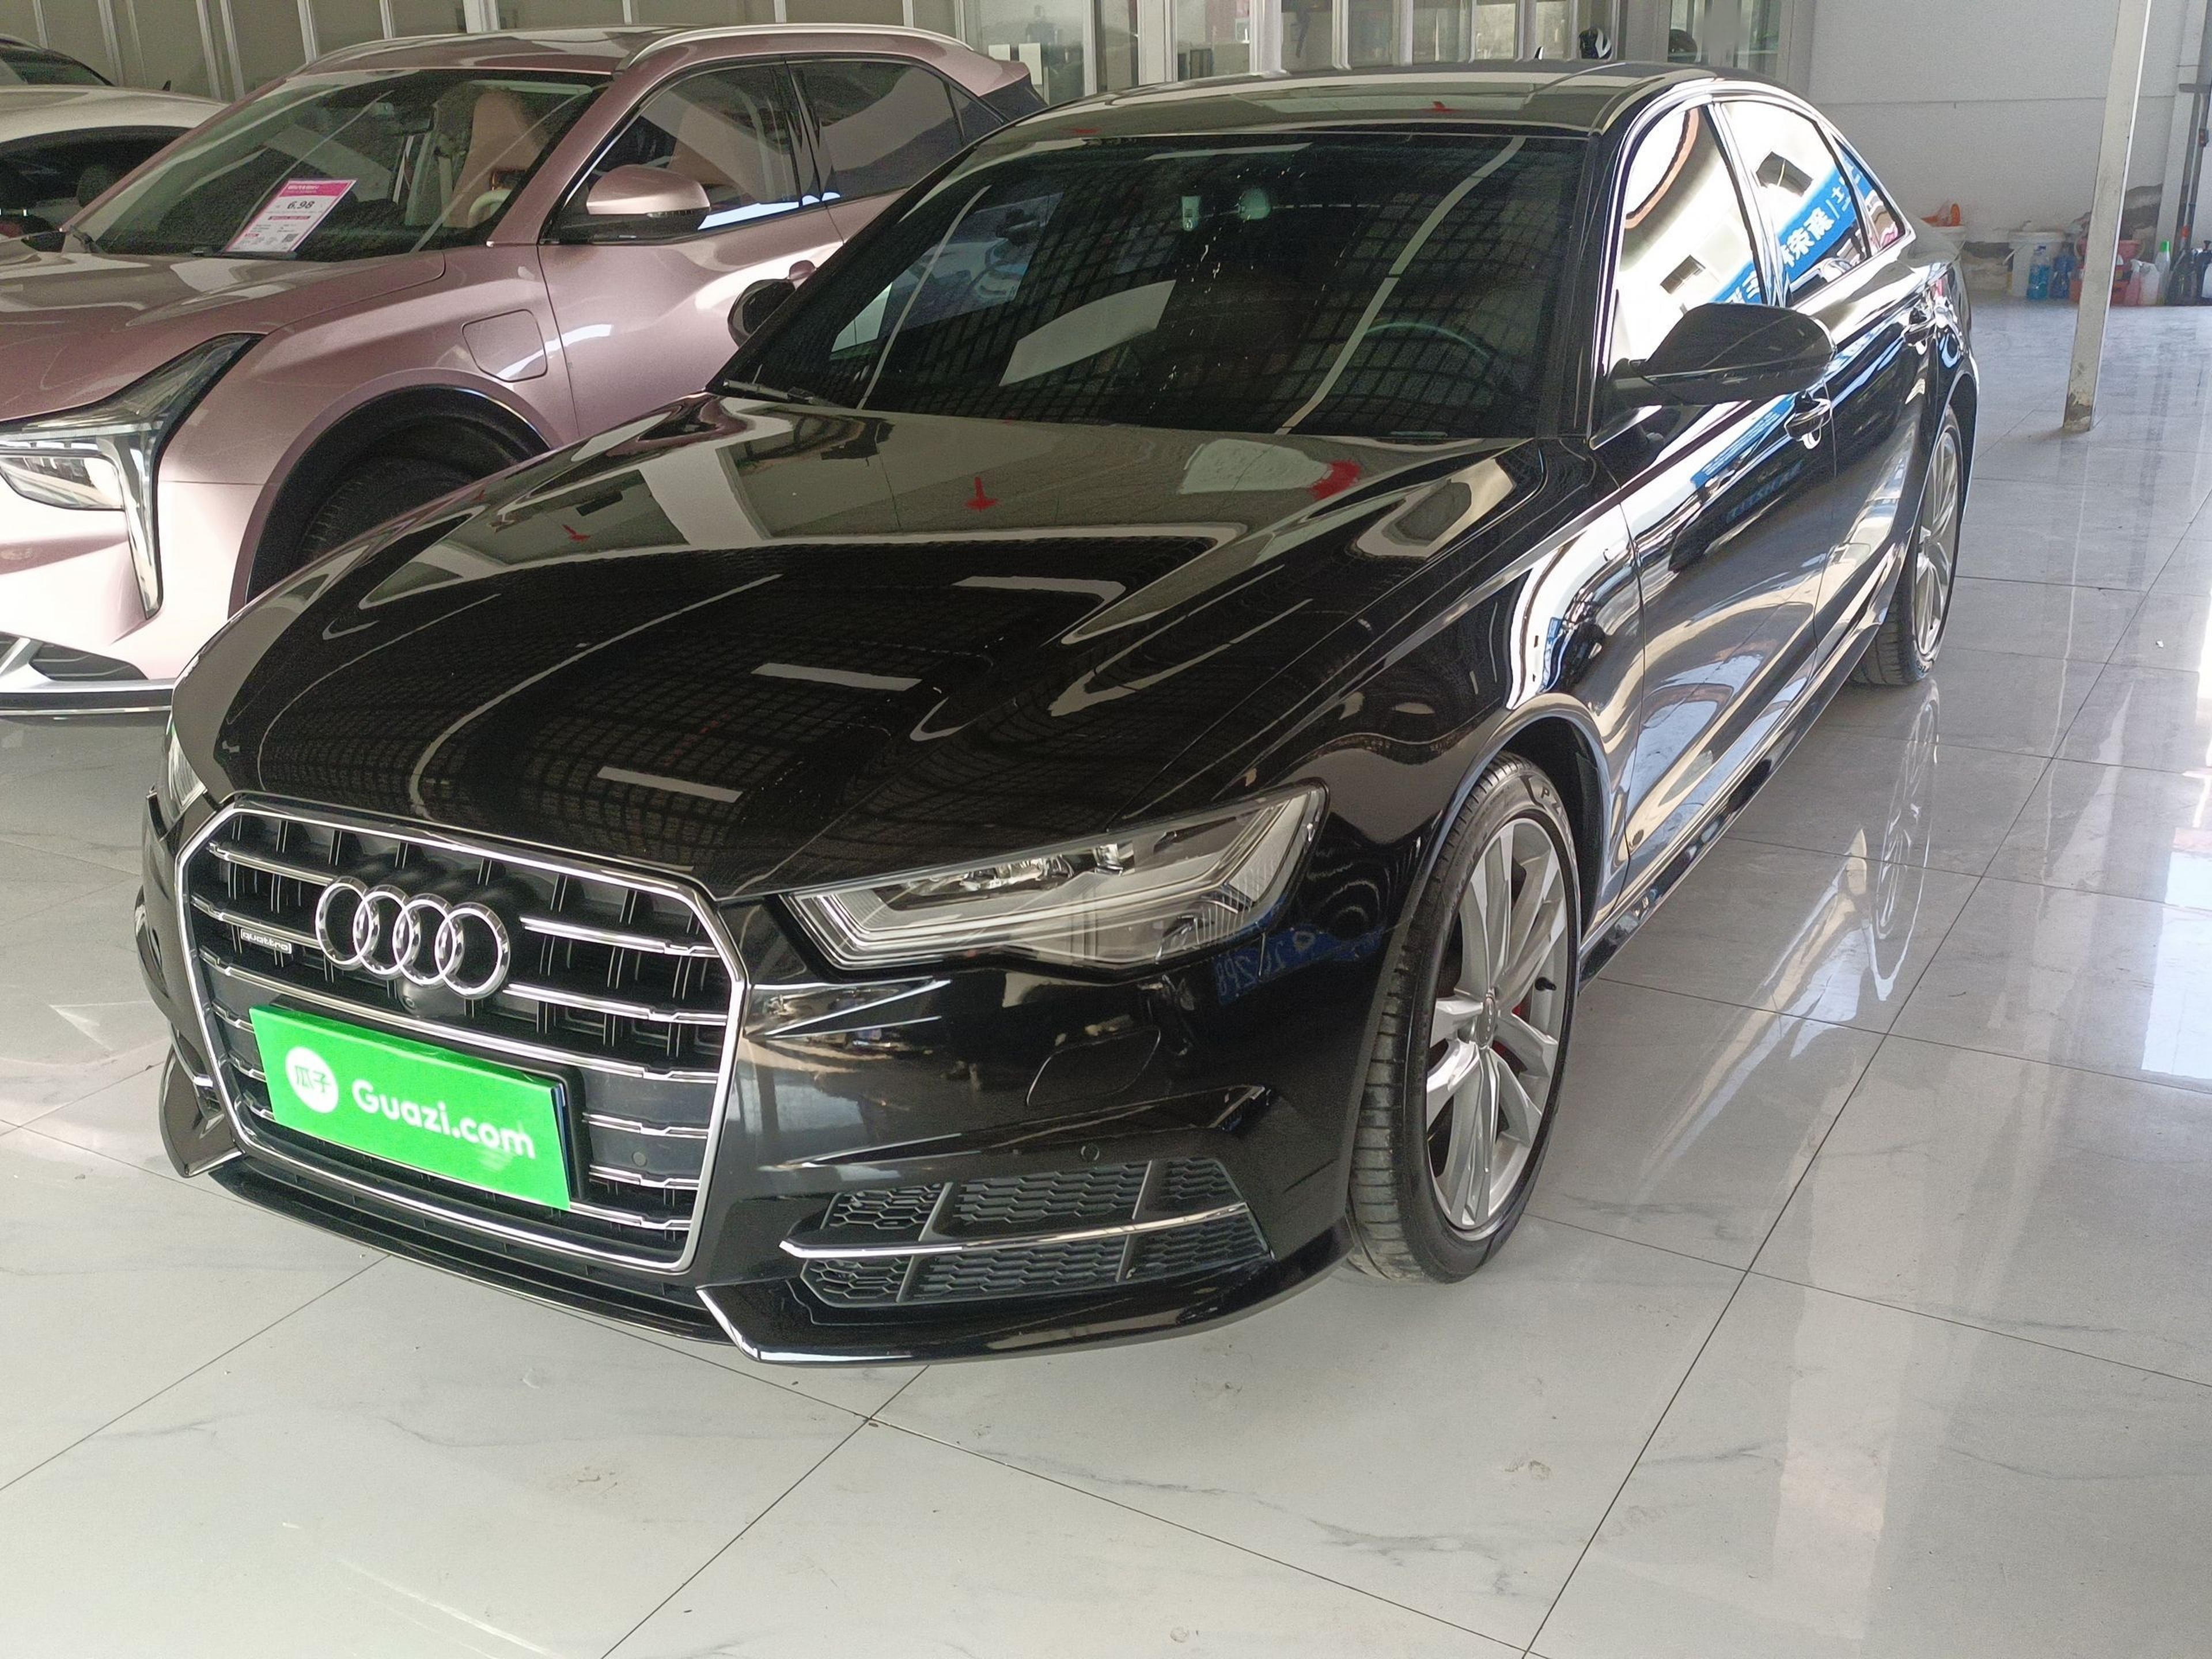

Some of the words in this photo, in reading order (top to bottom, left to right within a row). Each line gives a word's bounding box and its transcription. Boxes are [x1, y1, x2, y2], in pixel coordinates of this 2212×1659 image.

[287, 200, 315, 210] 6.98
[242, 931, 289, 952] quattro
[294, 1065, 332, 1093] 瓜子
[351, 1079, 536, 1160] Guazi.com
